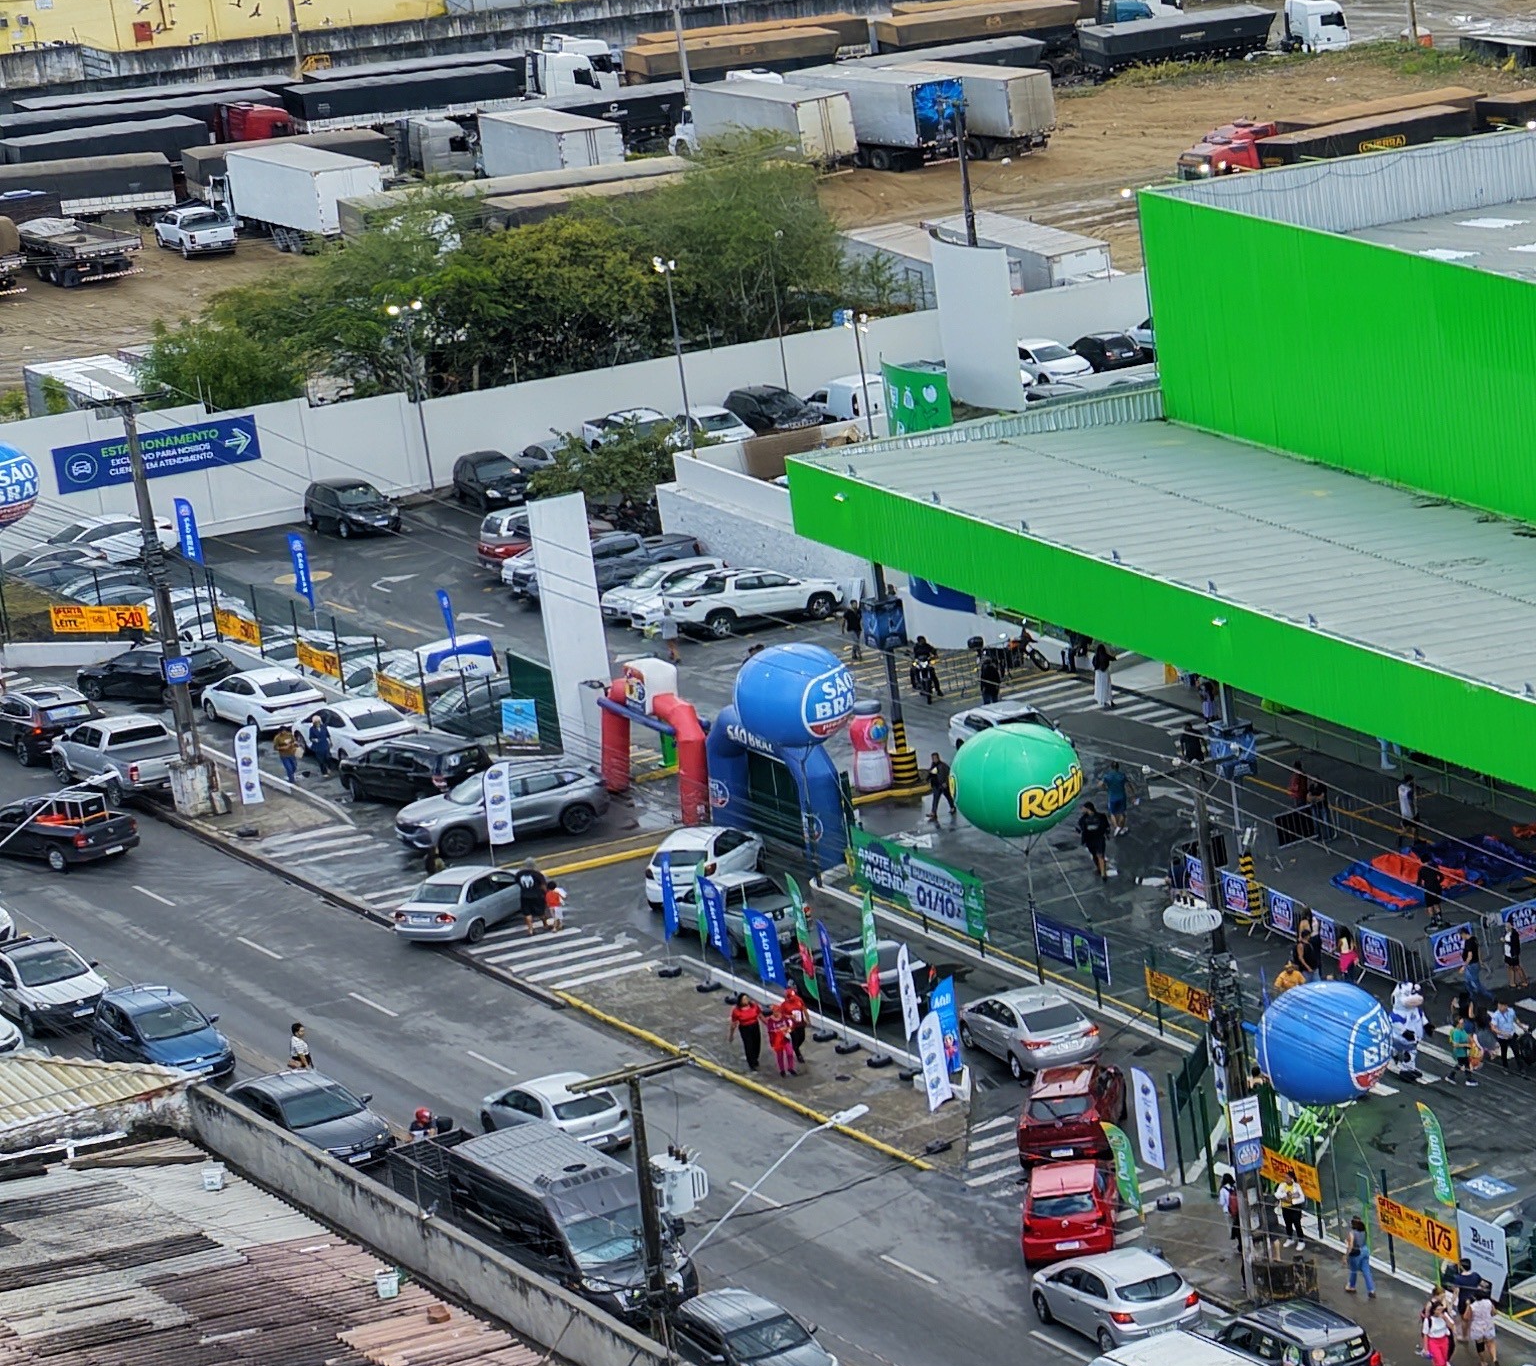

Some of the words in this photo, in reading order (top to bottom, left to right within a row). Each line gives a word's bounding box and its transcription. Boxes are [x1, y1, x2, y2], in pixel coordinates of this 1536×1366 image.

[101, 429, 219, 457] ESTAIONAMENTO
[111, 451, 155, 466] EXCLVO
[815, 693, 854, 720] BRA
